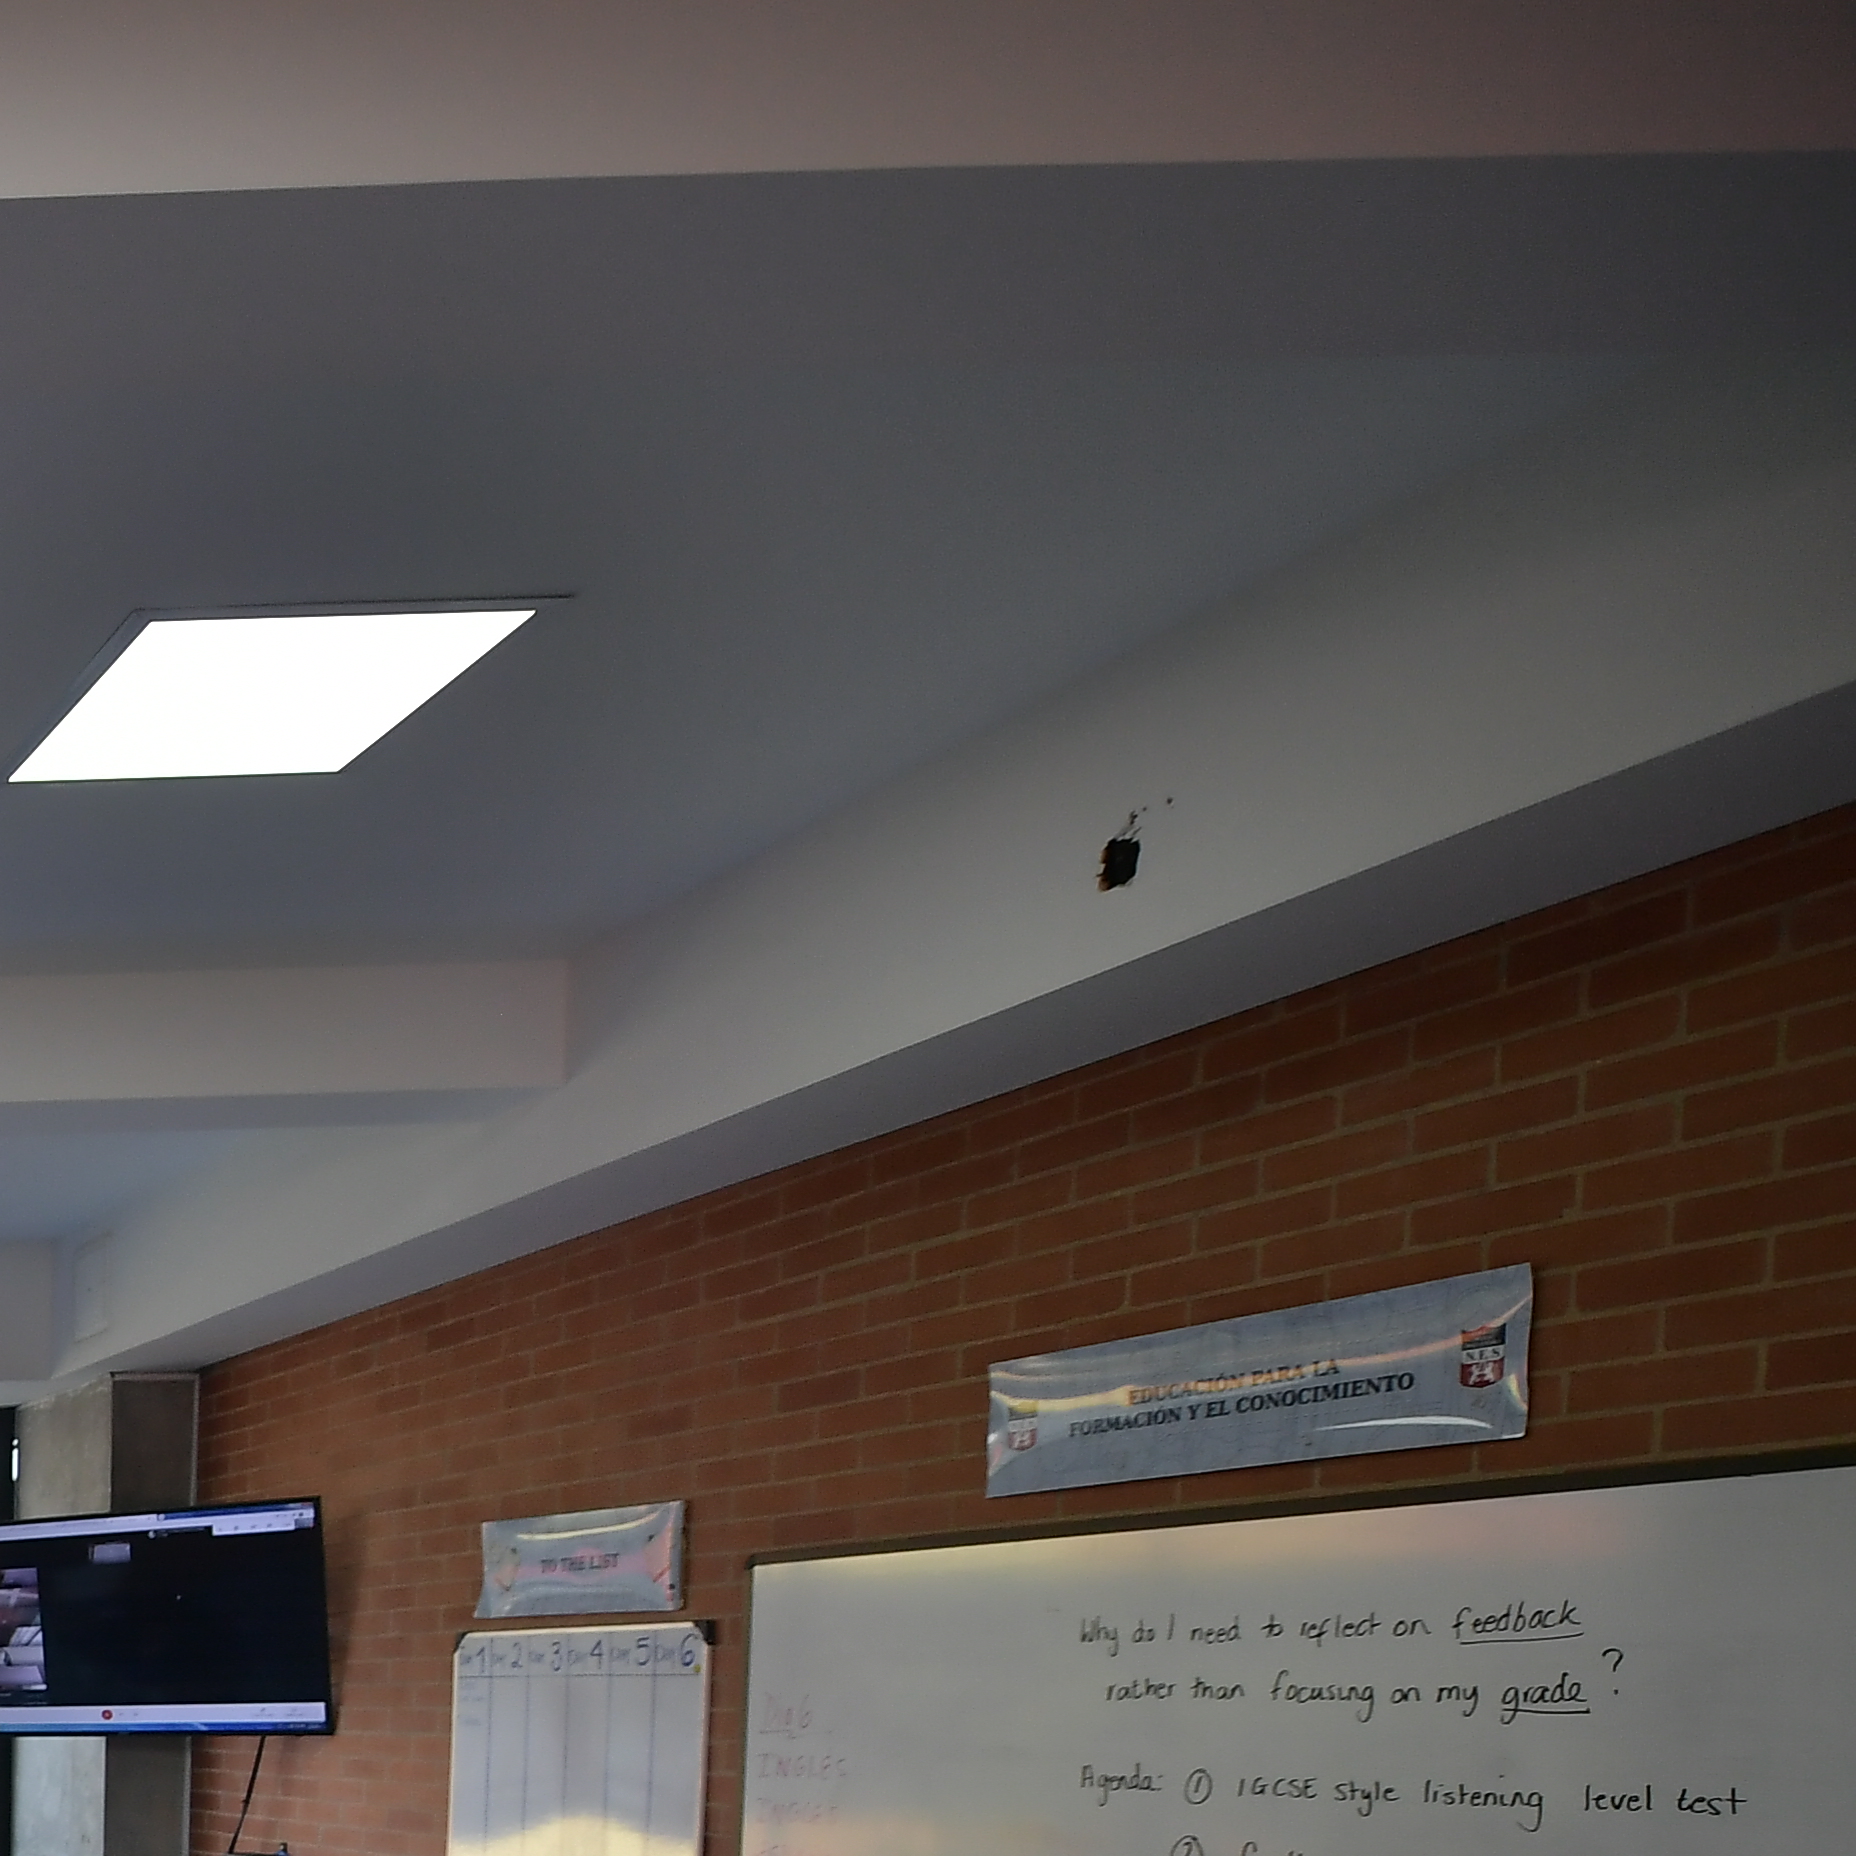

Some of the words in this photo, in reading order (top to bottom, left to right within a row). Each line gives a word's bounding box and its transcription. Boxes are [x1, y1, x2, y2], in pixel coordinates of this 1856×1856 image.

[1251, 1366, 1303, 1387] PARA
[1312, 1358, 1340, 1378] LA
[1068, 1404, 1182, 1438] FORMACIÓN
[1187, 1404, 1205, 1422] Y
[1205, 1399, 1231, 1420] EL
[1235, 1371, 1416, 1416] CONOCIMIENTO
[1079, 1614, 1119, 1657] Why
[1132, 1618, 1156, 1644] do
[1190, 1615, 1241, 1644] need
[1260, 1613, 1286, 1639] to
[1299, 1612, 1382, 1648] reflect
[1392, 1616, 1433, 1638] on
[1451, 1599, 1582, 1640] feedback
[476, 1646, 487, 1674] 1
[511, 1641, 524, 1669] 2
[551, 1640, 562, 1672] 3
[589, 1639, 605, 1671] 4
[635, 1635, 651, 1667] 5
[680, 1632, 699, 1668] 6
[1105, 1677, 1177, 1701] rather
[1190, 1675, 1245, 1700] than
[1269, 1669, 1375, 1724] focusing
[1391, 1685, 1422, 1704] on
[1436, 1684, 1479, 1718] my
[1500, 1671, 1589, 1725] grade
[1237, 1776, 1318, 1800] IGCSE
[1423, 1774, 1544, 1833] listening
[1584, 1784, 1654, 1814] level
[1676, 1786, 1749, 1816] test
